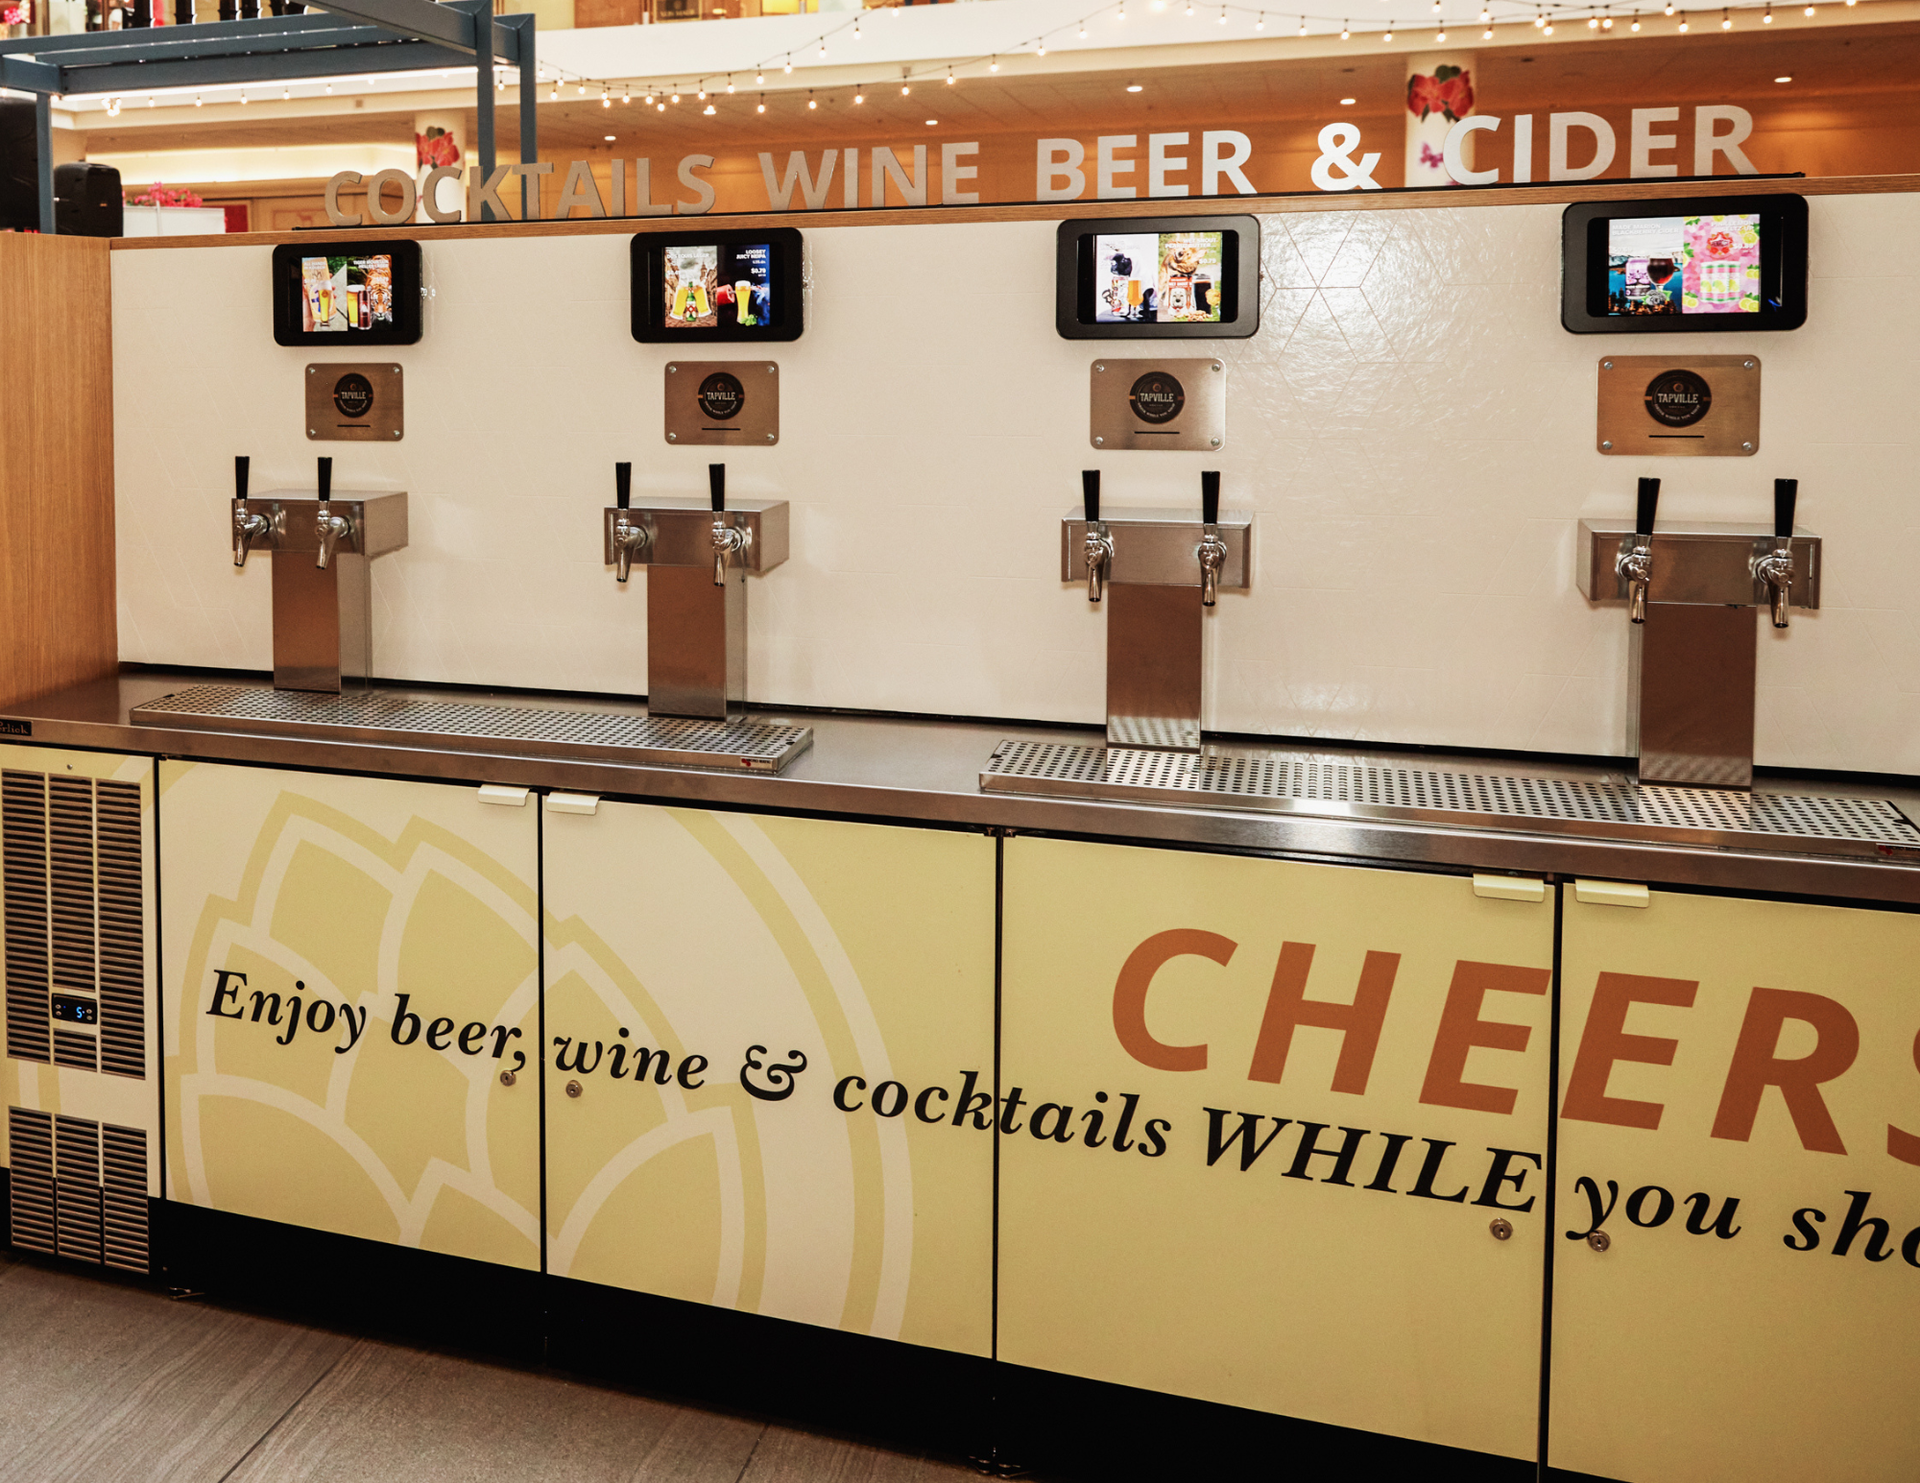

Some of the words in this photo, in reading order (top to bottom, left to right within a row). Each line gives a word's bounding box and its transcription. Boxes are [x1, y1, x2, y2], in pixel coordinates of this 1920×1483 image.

[324, 154, 716, 226] COCKTAILS
[758, 141, 980, 206] WINE
[1036, 129, 1257, 203] BEER
[1311, 122, 1382, 192] &
[1443, 104, 1759, 186] CIDER
[706, 392, 736, 400] TAPVILLE
[1140, 393, 1174, 402] TAPVILLE
[1658, 393, 1698, 403] TAPVILLE
[206, 969, 367, 1054] Enjoy
[391, 993, 526, 1076] beer,
[553, 1027, 708, 1091] wine
[740, 1045, 807, 1102] &
[833, 1070, 1172, 1157] cocktails
[1202, 1106, 1542, 1213] WHILE
[1565, 1176, 1742, 1252] you
